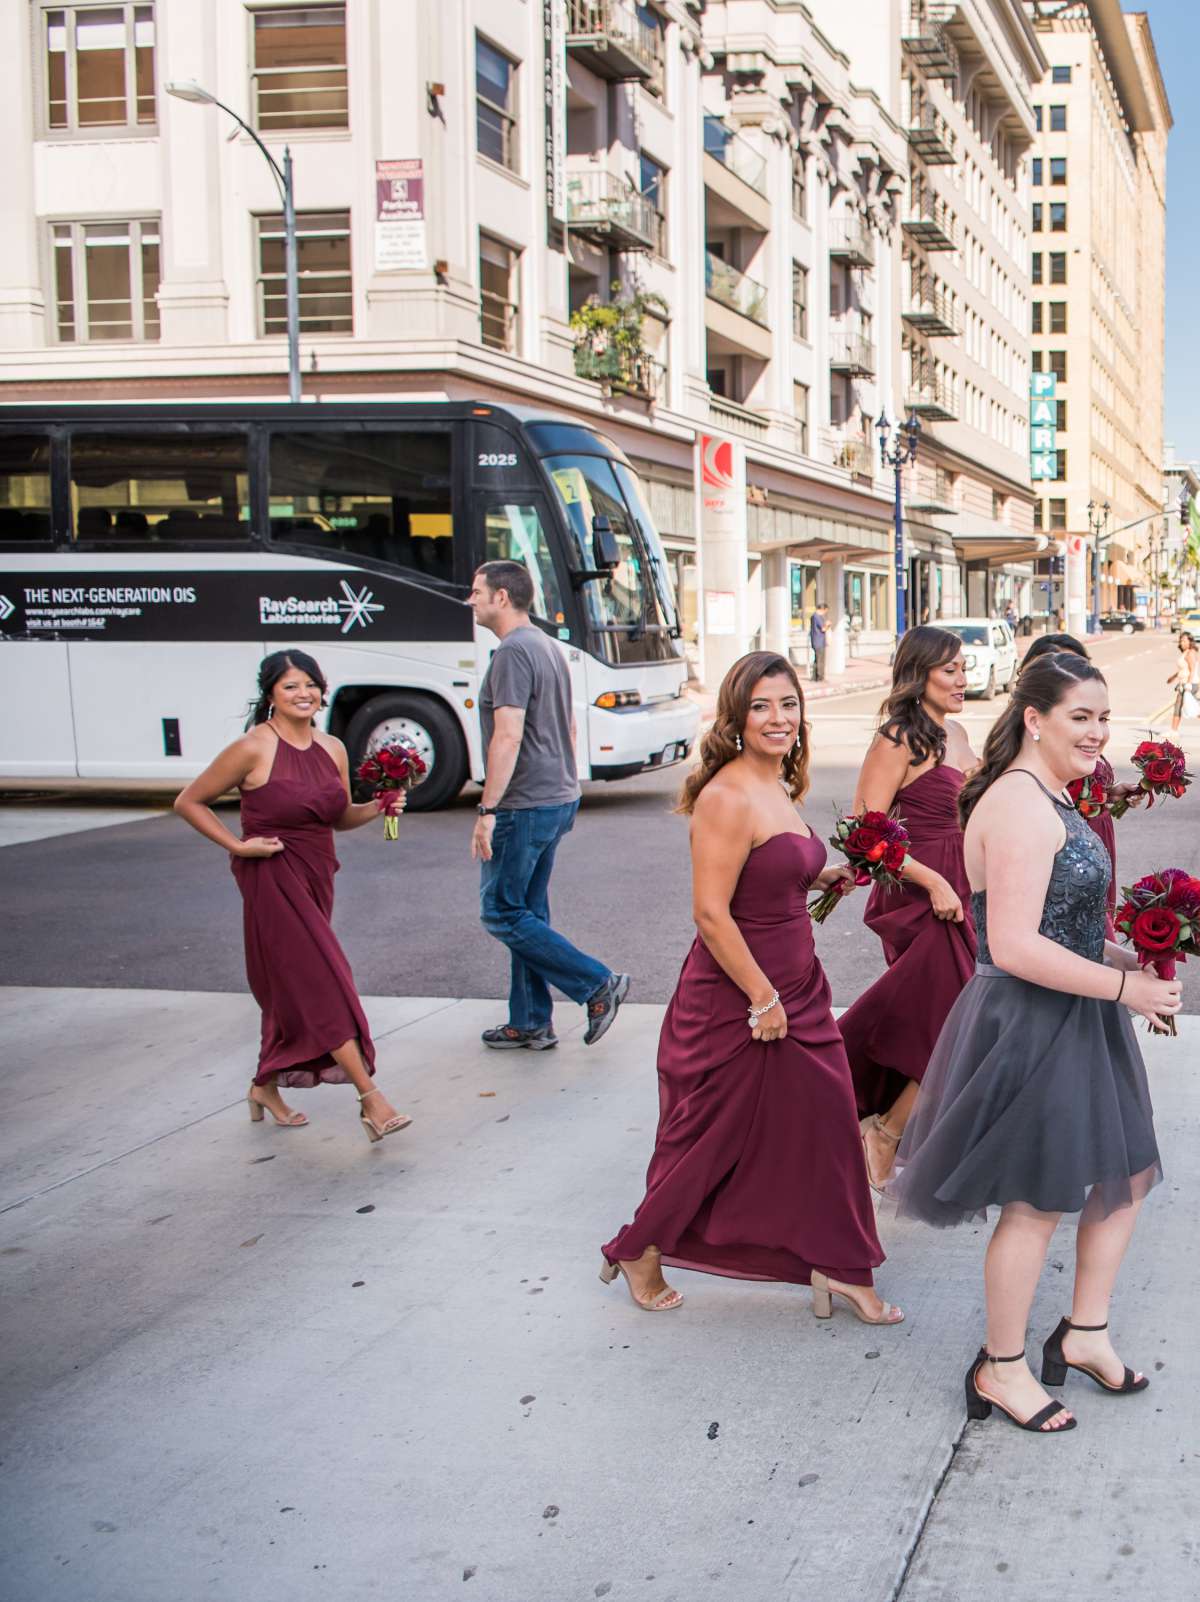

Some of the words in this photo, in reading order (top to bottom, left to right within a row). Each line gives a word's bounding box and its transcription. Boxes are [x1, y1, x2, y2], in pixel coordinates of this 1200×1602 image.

[545, 124, 554, 207] LEASE
[1034, 374, 1053, 476] PARK
[478, 454, 517, 466] 2025
[24, 588, 50, 603] THE
[52, 587, 171, 603] NEXT-GENERATION
[173, 587, 197, 603] OIS
[259, 596, 338, 614] RaySearch
[26, 618, 42, 627] visit
[53, 619, 61, 627] at
[261, 612, 341, 624] Laboratories
